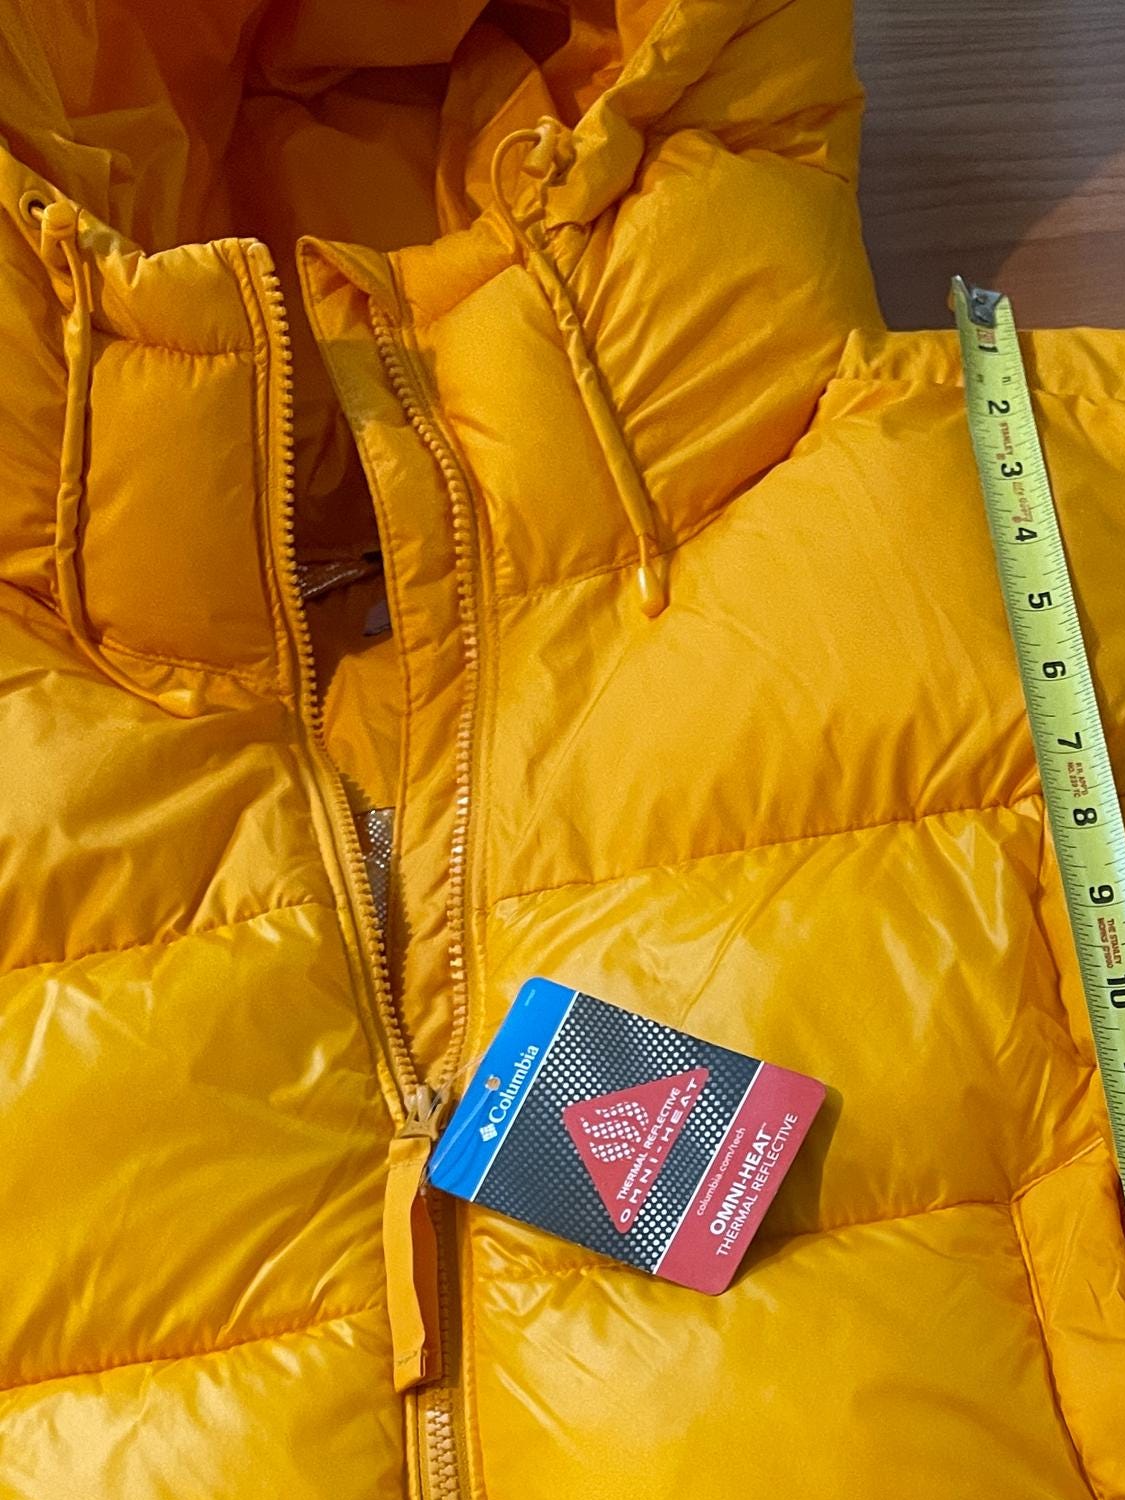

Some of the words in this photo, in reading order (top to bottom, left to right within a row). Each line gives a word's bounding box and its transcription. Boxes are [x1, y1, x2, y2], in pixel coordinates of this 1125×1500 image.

[988, 400, 1010, 415] 2
[1001, 462, 1023, 477] 3
[1015, 527, 1038, 541] 4
[1028, 591, 1052, 609] 5
[1042, 660, 1066, 678] 6
[1057, 732, 1083, 749] 7
[1073, 807, 1097, 826] 8
[1089, 884, 1114, 904] 9
[1110, 934, 1122, 965] STANLEY
[489, 1045, 540, 1123] Columbia
[616, 1152, 648, 1200] THERMAL
[643, 1087, 681, 1150] REFLECTIVE
[619, 1077, 698, 1223] OMNI-HEAT
[697, 1127, 746, 1216] columbia.com/tech
[716, 1194, 758, 1256] THERMAL
[751, 1113, 798, 1192] REFLECTIVE
